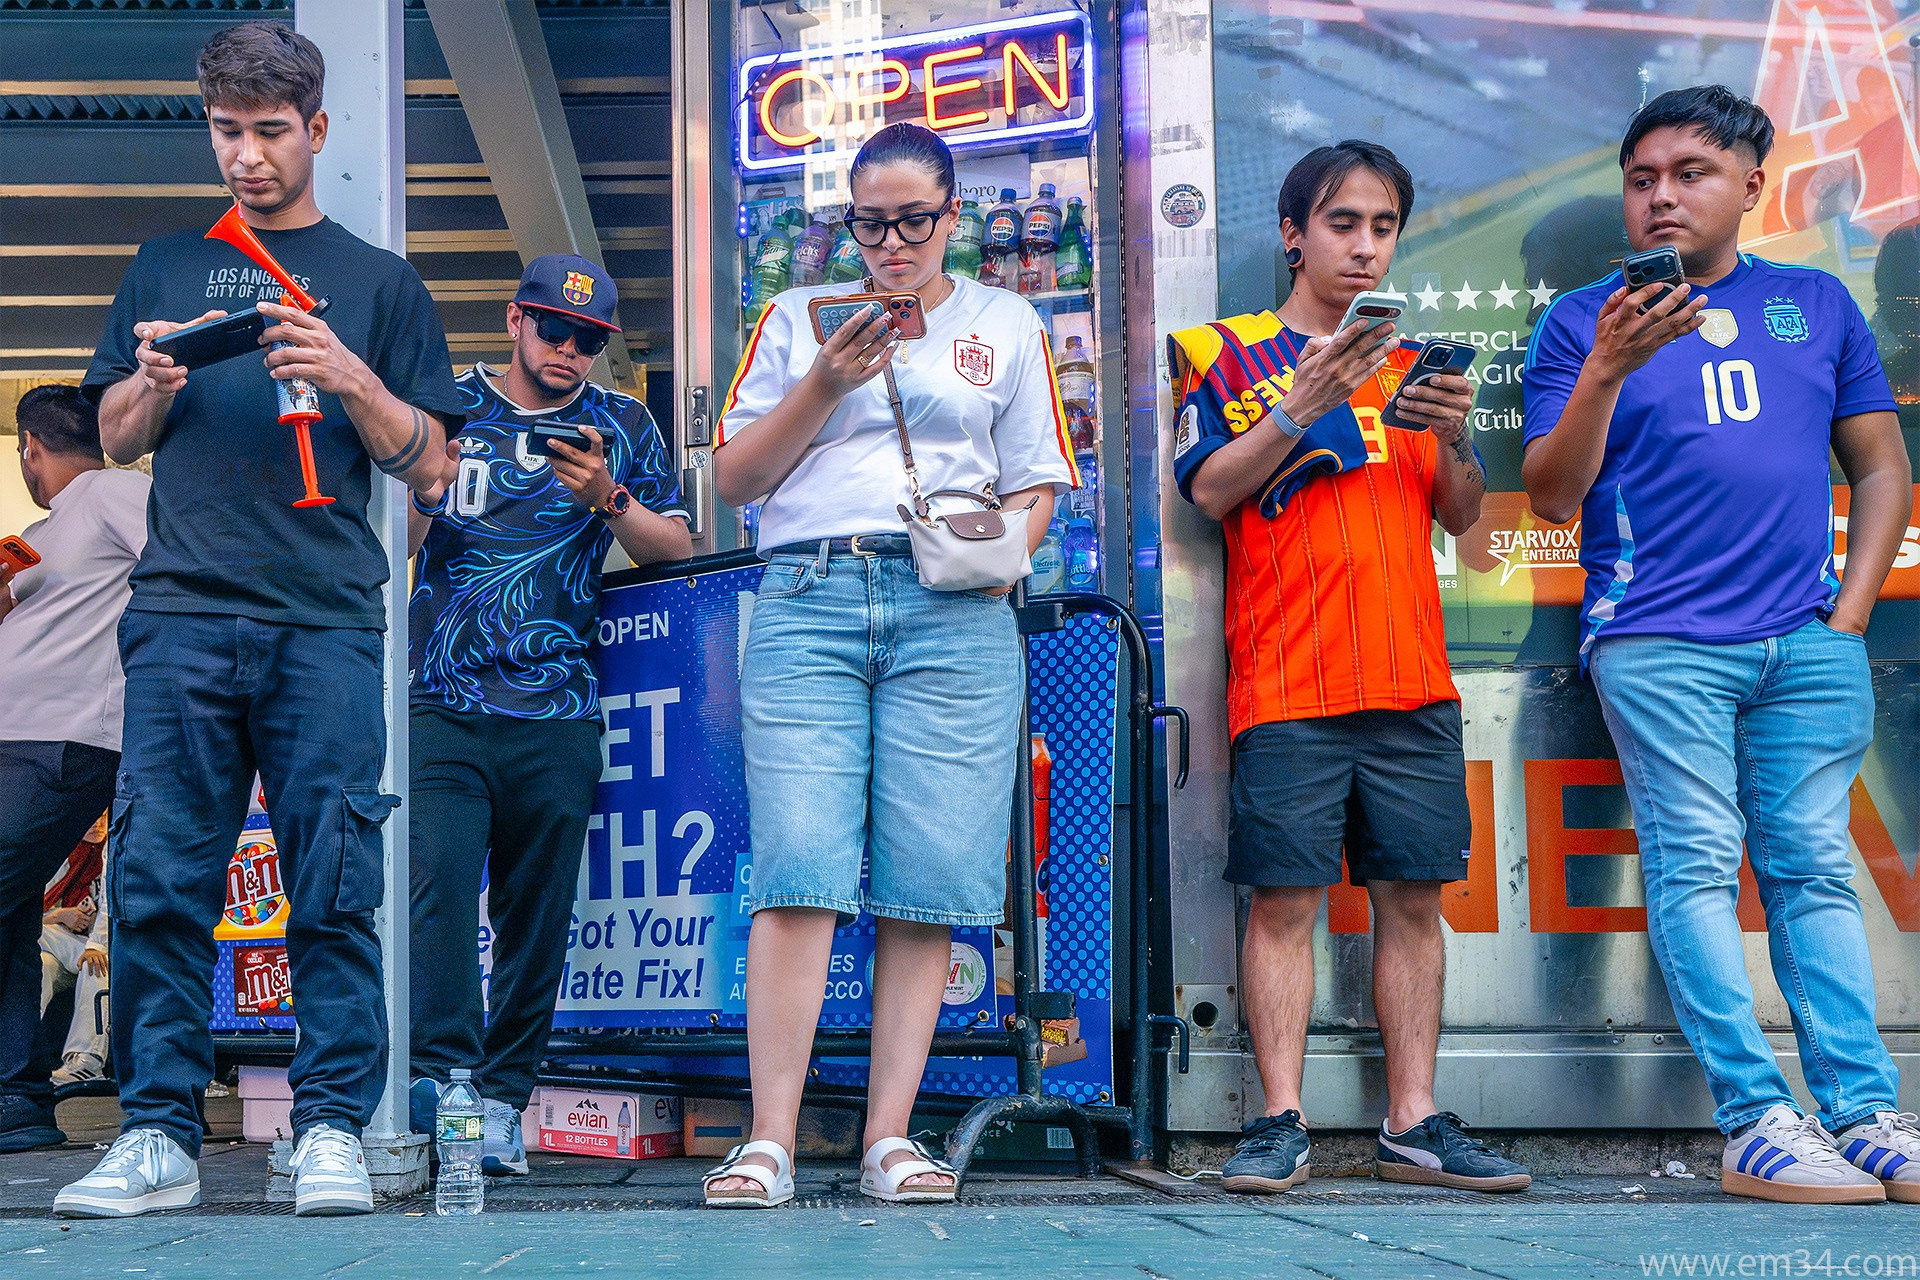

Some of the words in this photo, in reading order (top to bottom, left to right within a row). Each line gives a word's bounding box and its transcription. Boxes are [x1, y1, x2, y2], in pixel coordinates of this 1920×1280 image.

[760, 34, 1069, 147] OPEN
[208, 268, 238, 284] LOS
[206, 285, 236, 298] CITY
[238, 284, 255, 298] OF
[1777, 316, 1799, 332] AFA
[1701, 360, 1761, 425] 10
[524, 455, 538, 463] FIFA
[1489, 521, 1581, 549] STARVOX
[1438, 580, 1457, 588] GES
[599, 610, 669, 646] OPEN
[627, 908, 714, 948] Your
[635, 957, 704, 999] Fix!
[568, 1111, 608, 1129] evian
[543, 1133, 556, 1147] 1L
[565, 1134, 573, 1143] 12
[575, 1136, 608, 1146] BOTTLES
[642, 1138, 655, 1155] 1L
